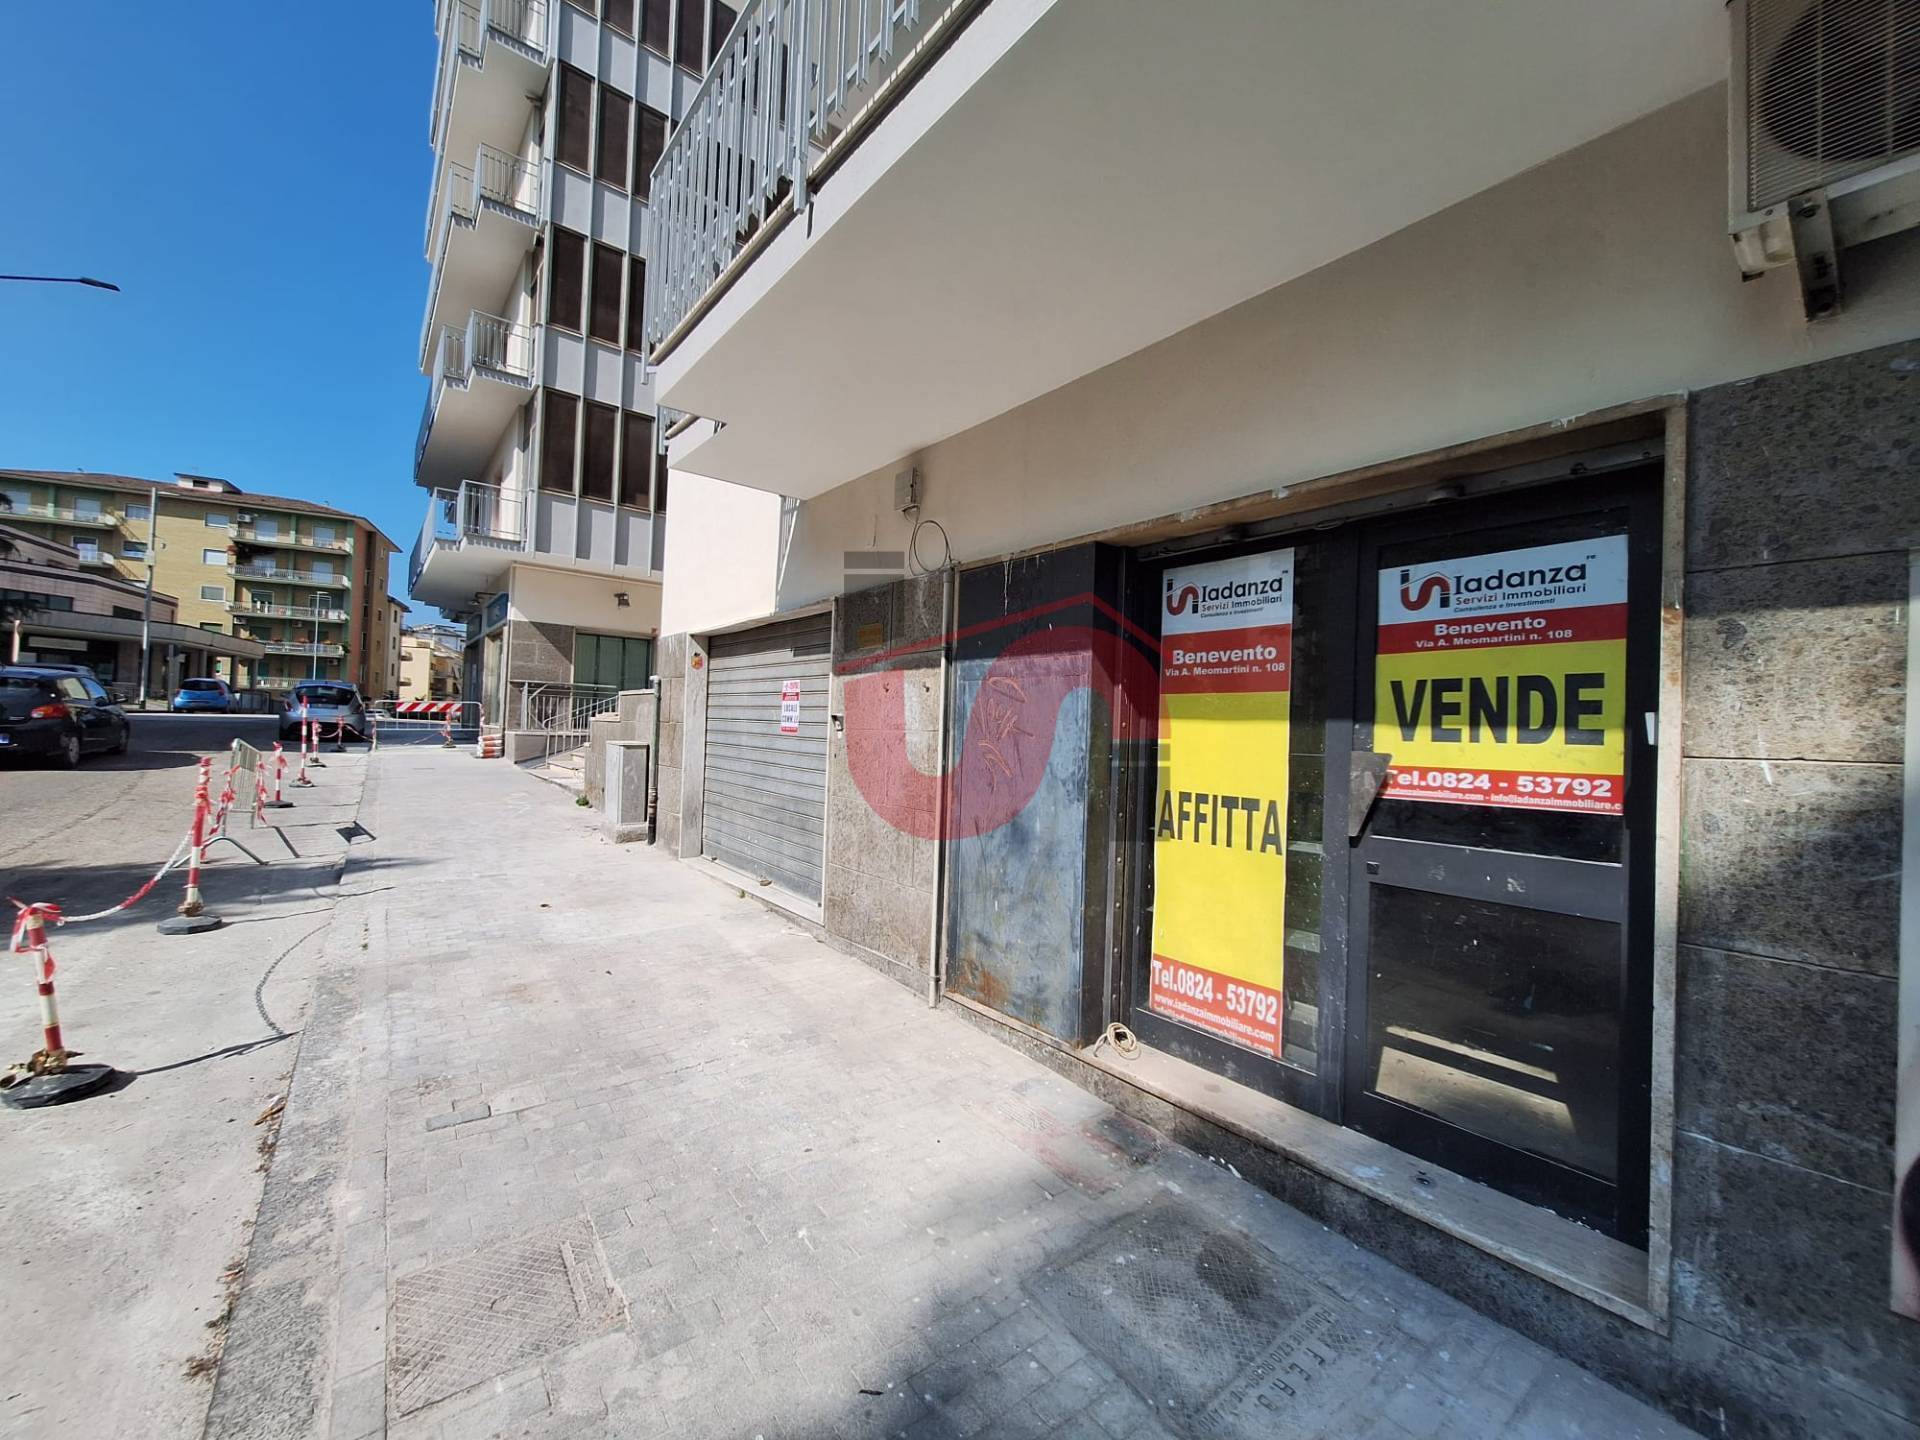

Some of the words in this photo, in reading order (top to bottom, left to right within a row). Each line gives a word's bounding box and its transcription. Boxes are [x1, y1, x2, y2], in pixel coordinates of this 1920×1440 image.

[1201, 577, 1283, 603] Iadanza
[1453, 563, 1587, 595] Iadanza
[1201, 602, 1229, 612] Servizi
[1231, 595, 1283, 609] Immobiliari
[1455, 592, 1497, 606] Servizi
[1502, 583, 1586, 600] Immobiliari
[1415, 640, 1435, 648] Via
[1437, 638, 1450, 647] A.
[1452, 632, 1526, 646] Meomartini
[1529, 632, 1543, 641] n.
[1546, 628, 1574, 639] 108
[1433, 616, 1547, 636] Benevento
[1172, 644, 1277, 665] Benevento
[1165, 668, 1179, 677] Via
[1181, 667, 1191, 676] A.
[1193, 665, 1250, 676] Meomartini
[1252, 665, 1262, 673] n.
[1265, 662, 1286, 672] 108
[1389, 671, 1606, 746] VENDE
[1386, 769, 1492, 790] Tel.0824
[1516, 775, 1613, 797] 53792
[1157, 789, 1283, 856] AFFITTA
[1151, 959, 1214, 1003] Tel.0824
[1226, 983, 1278, 1026] 53792
